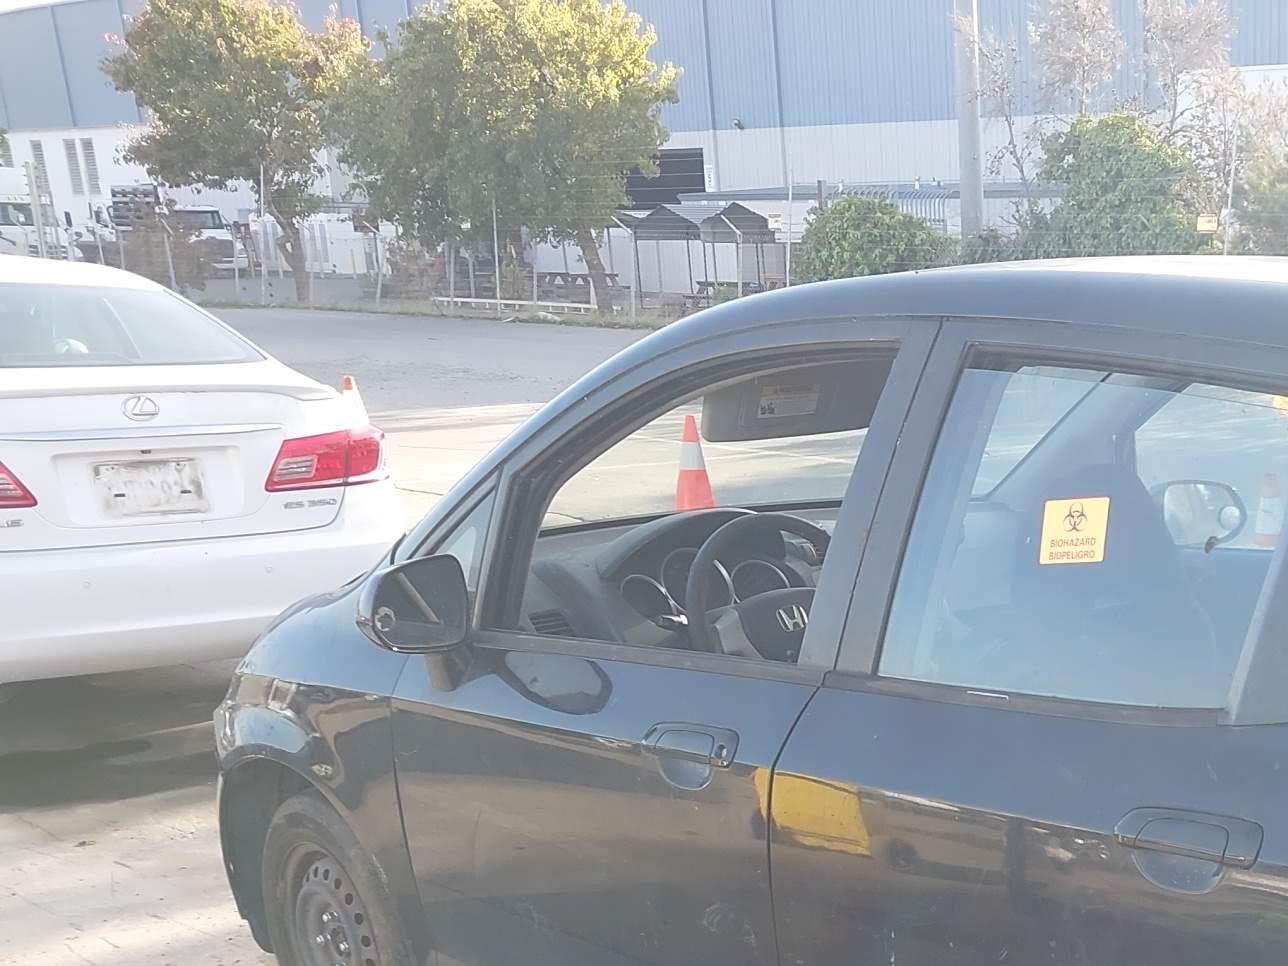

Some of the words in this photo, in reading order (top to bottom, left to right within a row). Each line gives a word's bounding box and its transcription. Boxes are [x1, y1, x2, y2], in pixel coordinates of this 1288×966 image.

[283, 500, 305, 509] ES
[307, 498, 337, 508] 350
[1050, 537, 1097, 548] BIOHAZARD
[1048, 550, 1096, 561] BIOPELIGRO
